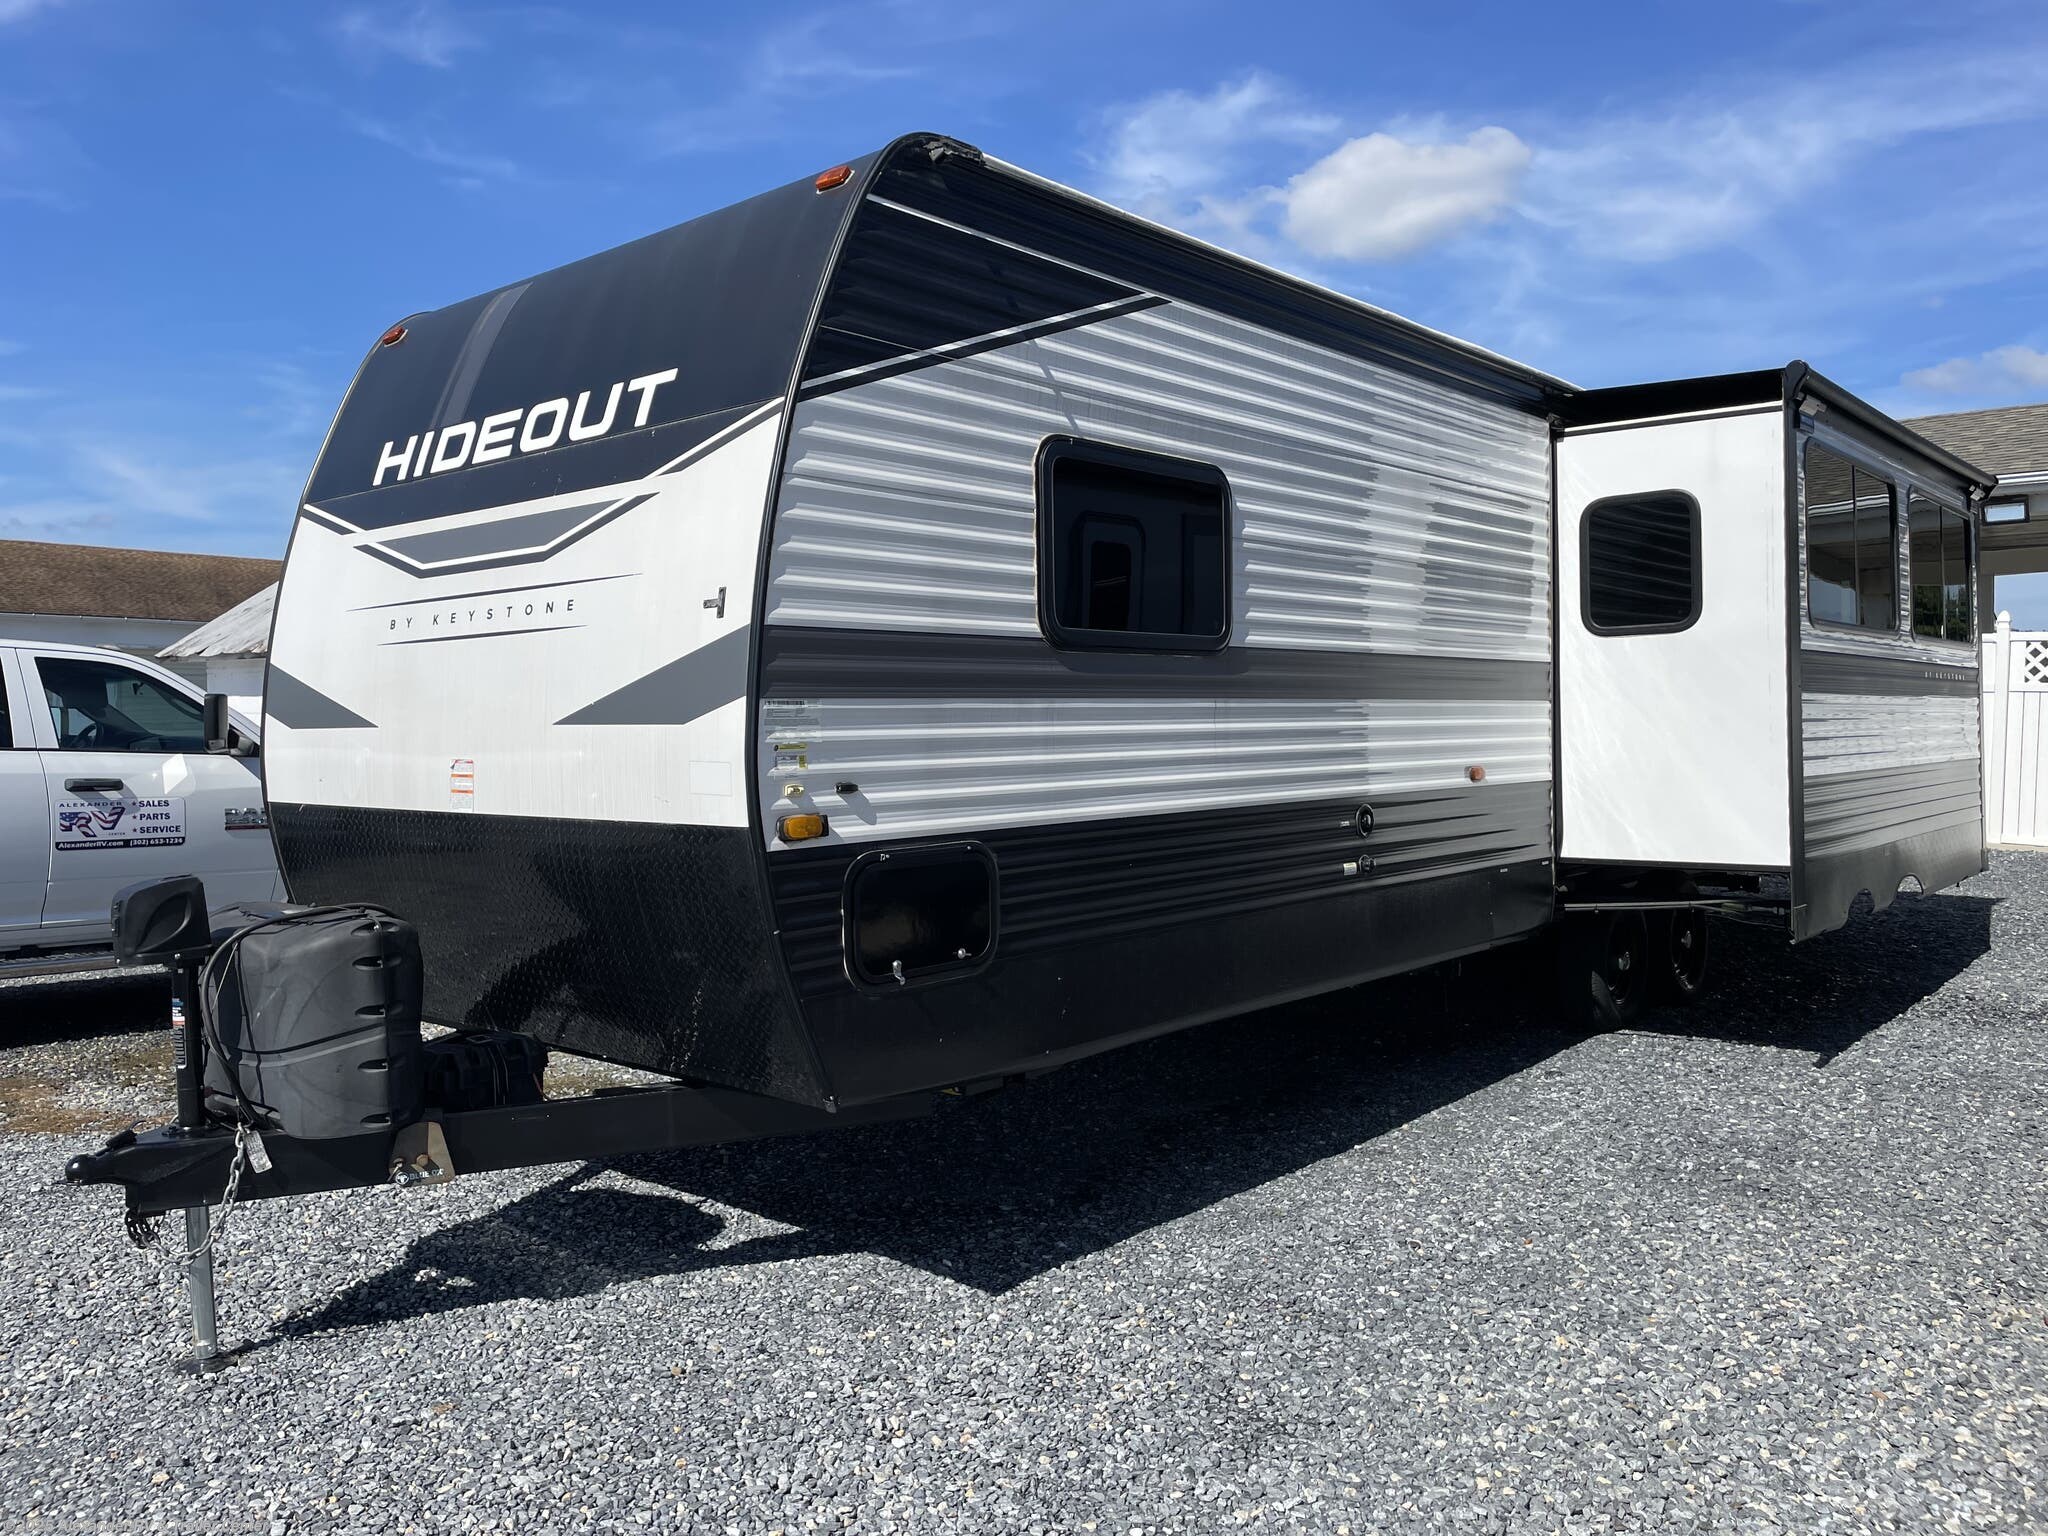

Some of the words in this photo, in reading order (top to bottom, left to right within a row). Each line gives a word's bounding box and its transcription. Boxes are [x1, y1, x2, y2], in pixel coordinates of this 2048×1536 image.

[372, 367, 679, 487] HIDEOUT
[390, 617, 413, 630] BY
[432, 599, 575, 626] KEYSTONE
[139, 800, 170, 808] SALES
[139, 812, 171, 820] PARTS
[59, 806, 126, 838] RV
[139, 825, 182, 833] SERVICE
[58, 841, 124, 849] AlexanderRV.com
[129, 839, 149, 847] (302)
